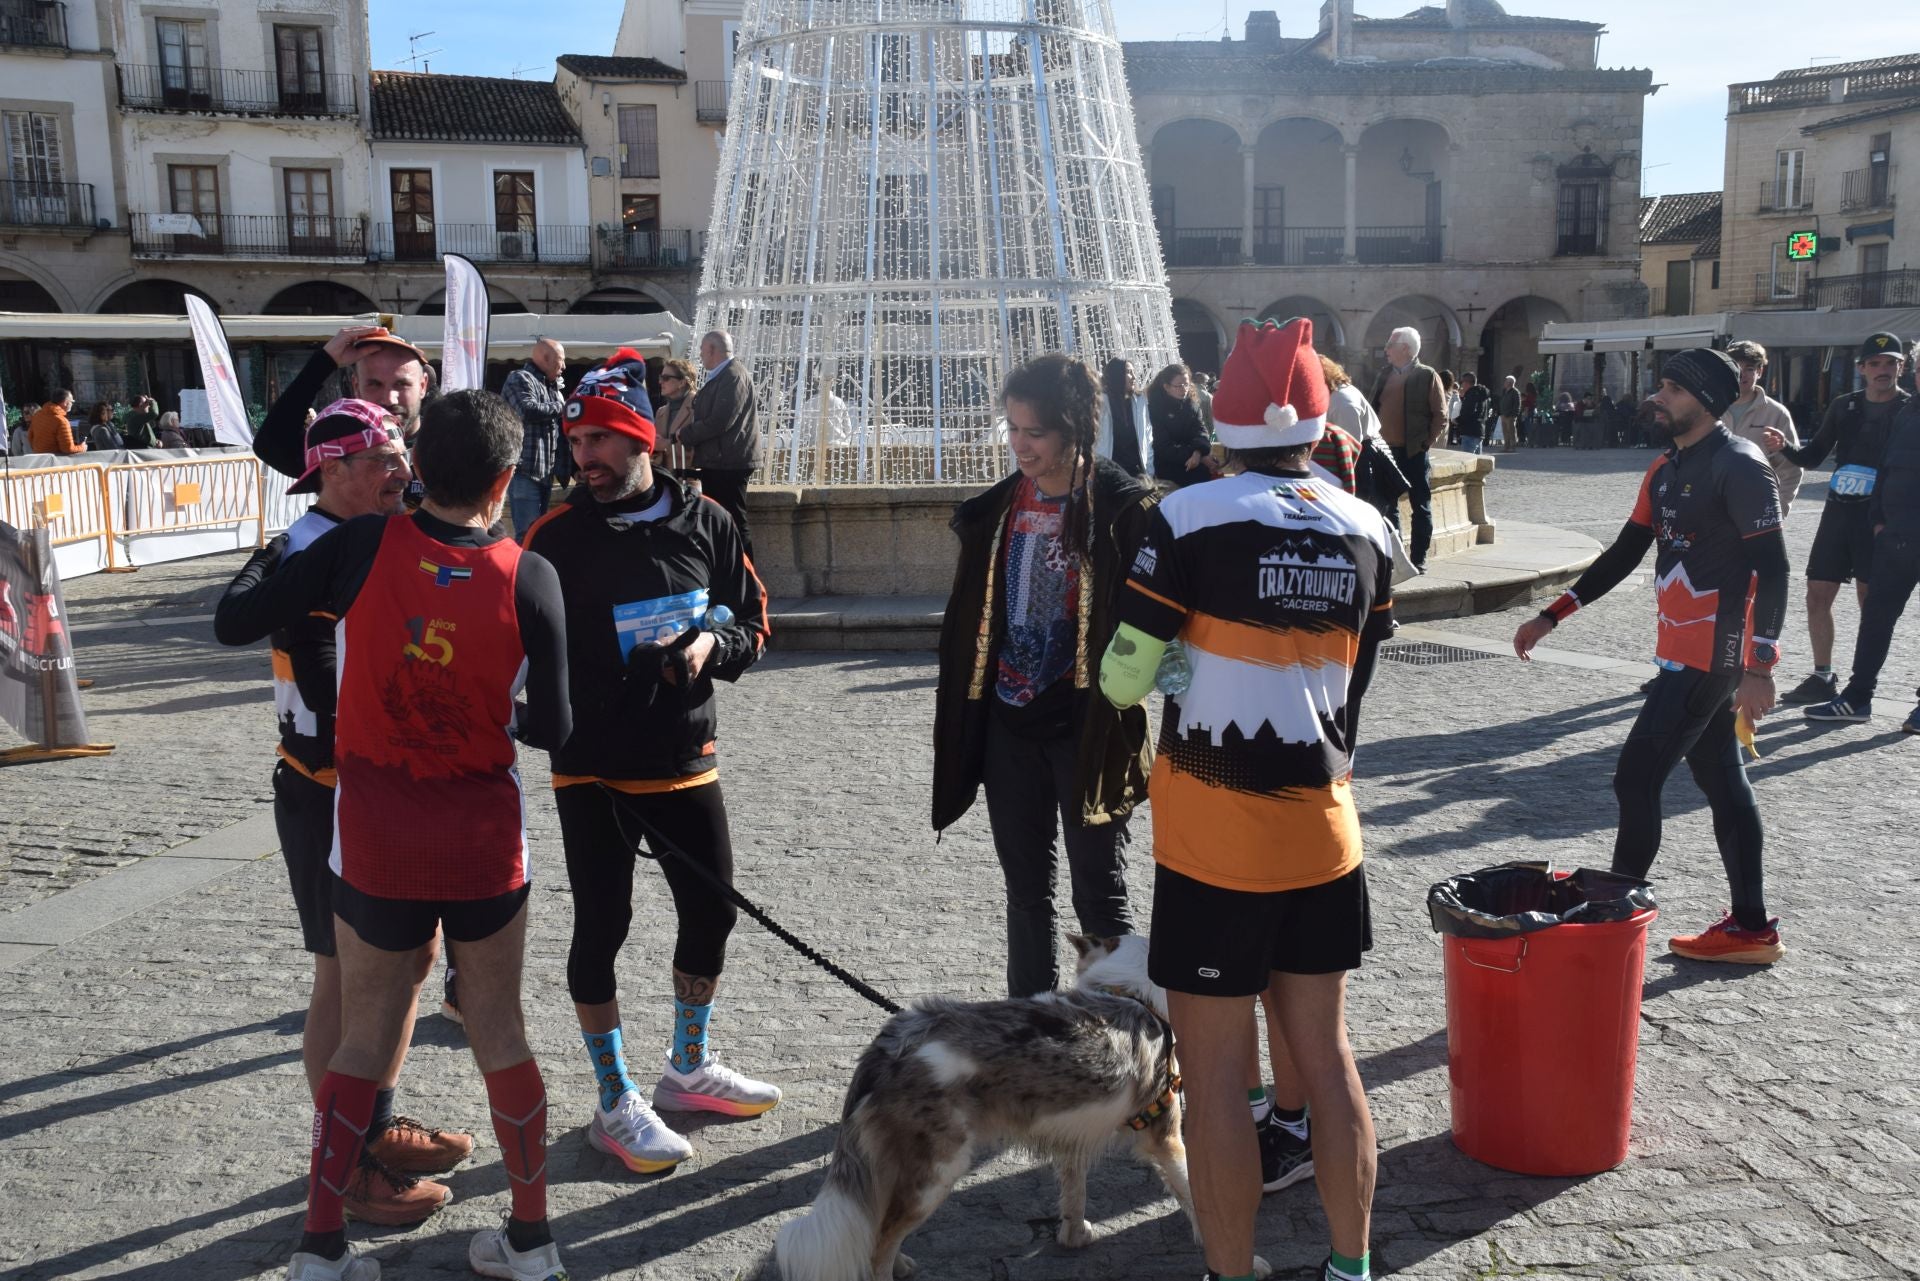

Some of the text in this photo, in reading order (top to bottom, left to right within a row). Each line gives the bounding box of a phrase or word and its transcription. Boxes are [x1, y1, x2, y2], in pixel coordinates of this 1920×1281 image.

[1836, 475, 1867, 496] 524
[1133, 550, 1158, 577] UNNER
[1258, 567, 1356, 606] CRAZYRUNNER
[429, 618, 456, 632] AÑOS
[403, 616, 453, 667] 15
[1723, 631, 1740, 668] TRAIL
